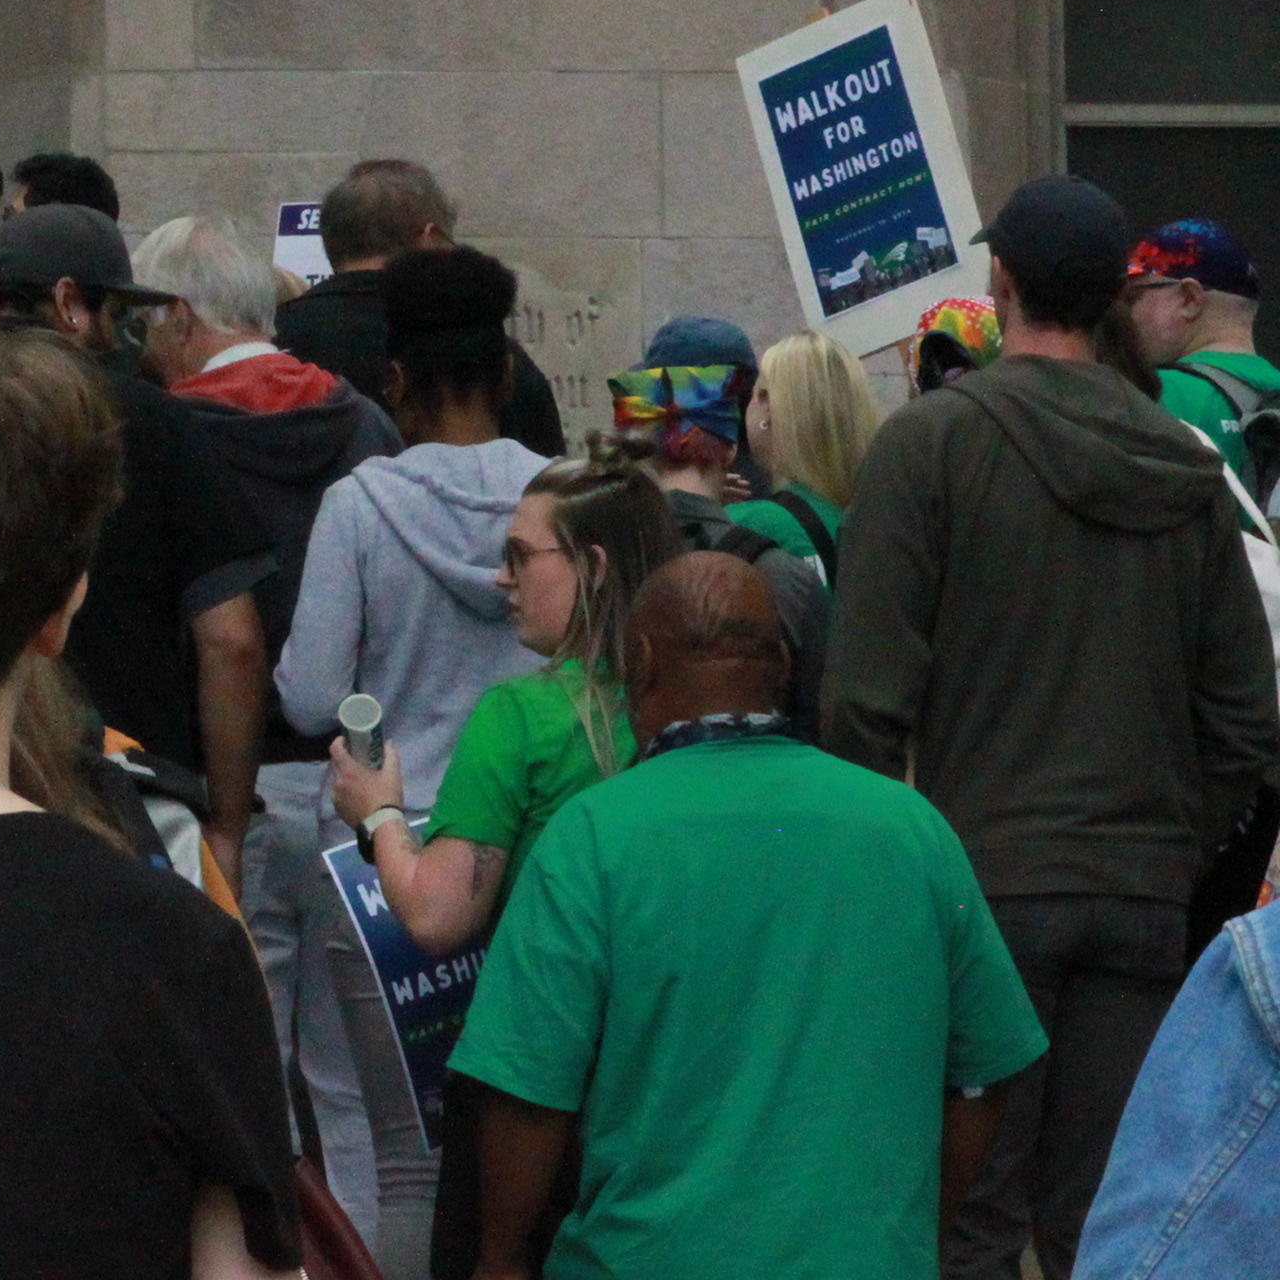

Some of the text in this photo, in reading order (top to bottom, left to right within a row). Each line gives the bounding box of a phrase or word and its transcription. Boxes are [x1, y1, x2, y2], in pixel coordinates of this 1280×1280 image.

[774, 58, 893, 134] WALKOUT
[822, 115, 867, 149] FOR
[793, 131, 919, 201] WASHINGTON
[835, 186, 893, 216] CONTRACT
